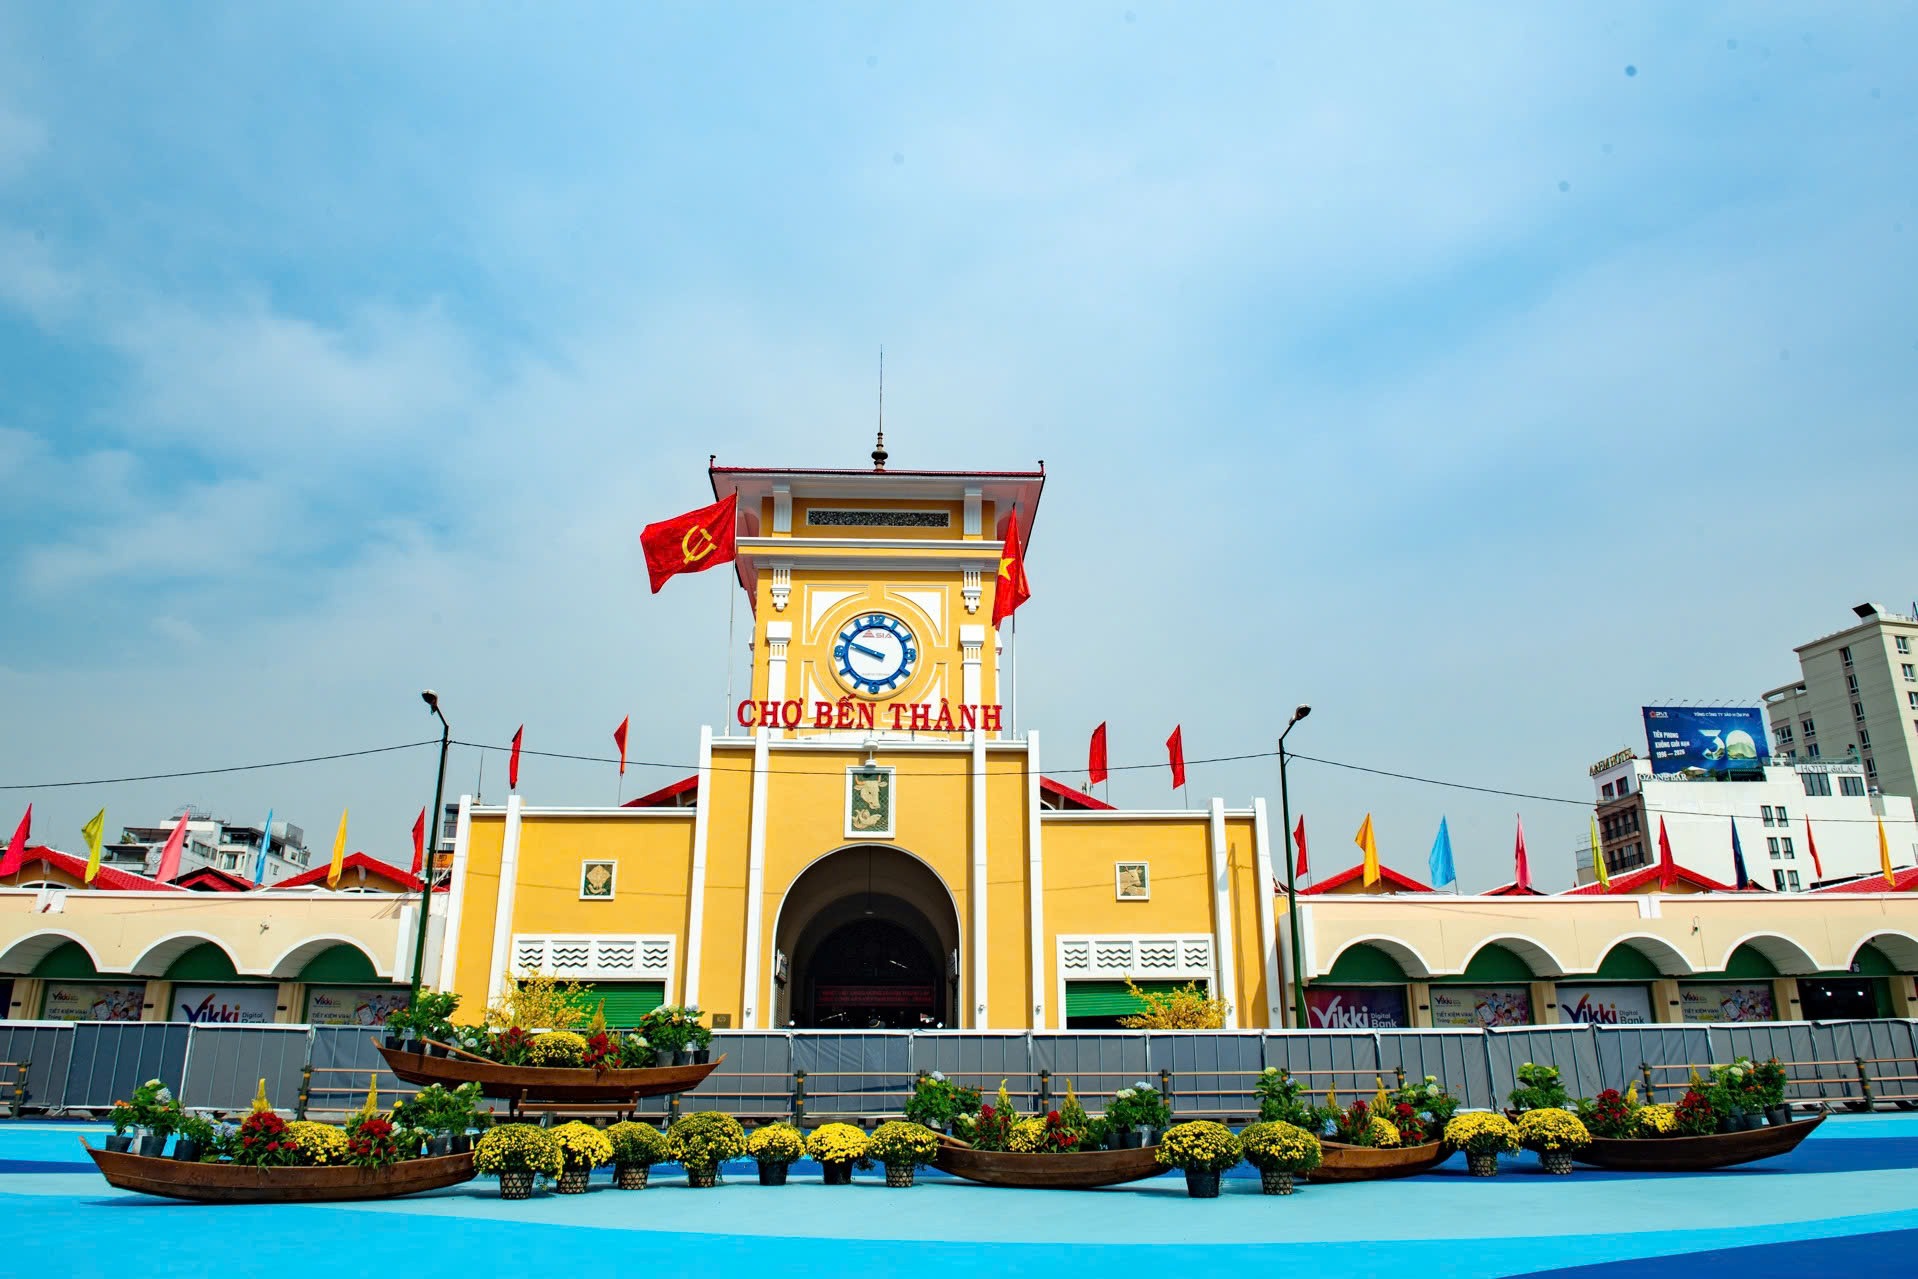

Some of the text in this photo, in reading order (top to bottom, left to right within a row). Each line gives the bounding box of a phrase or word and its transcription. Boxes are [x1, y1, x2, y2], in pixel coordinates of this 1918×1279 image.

[737, 693, 1002, 731] CHỢ BẾN THÀNH
[1698, 729, 1756, 760] 30
[182, 993, 240, 1023] Vikki
[1311, 996, 1368, 1028] Vikki
[1372, 1019, 1397, 1028] Bank
[1562, 993, 1617, 1024] Vikki
[1620, 1016, 1644, 1024] Bank
